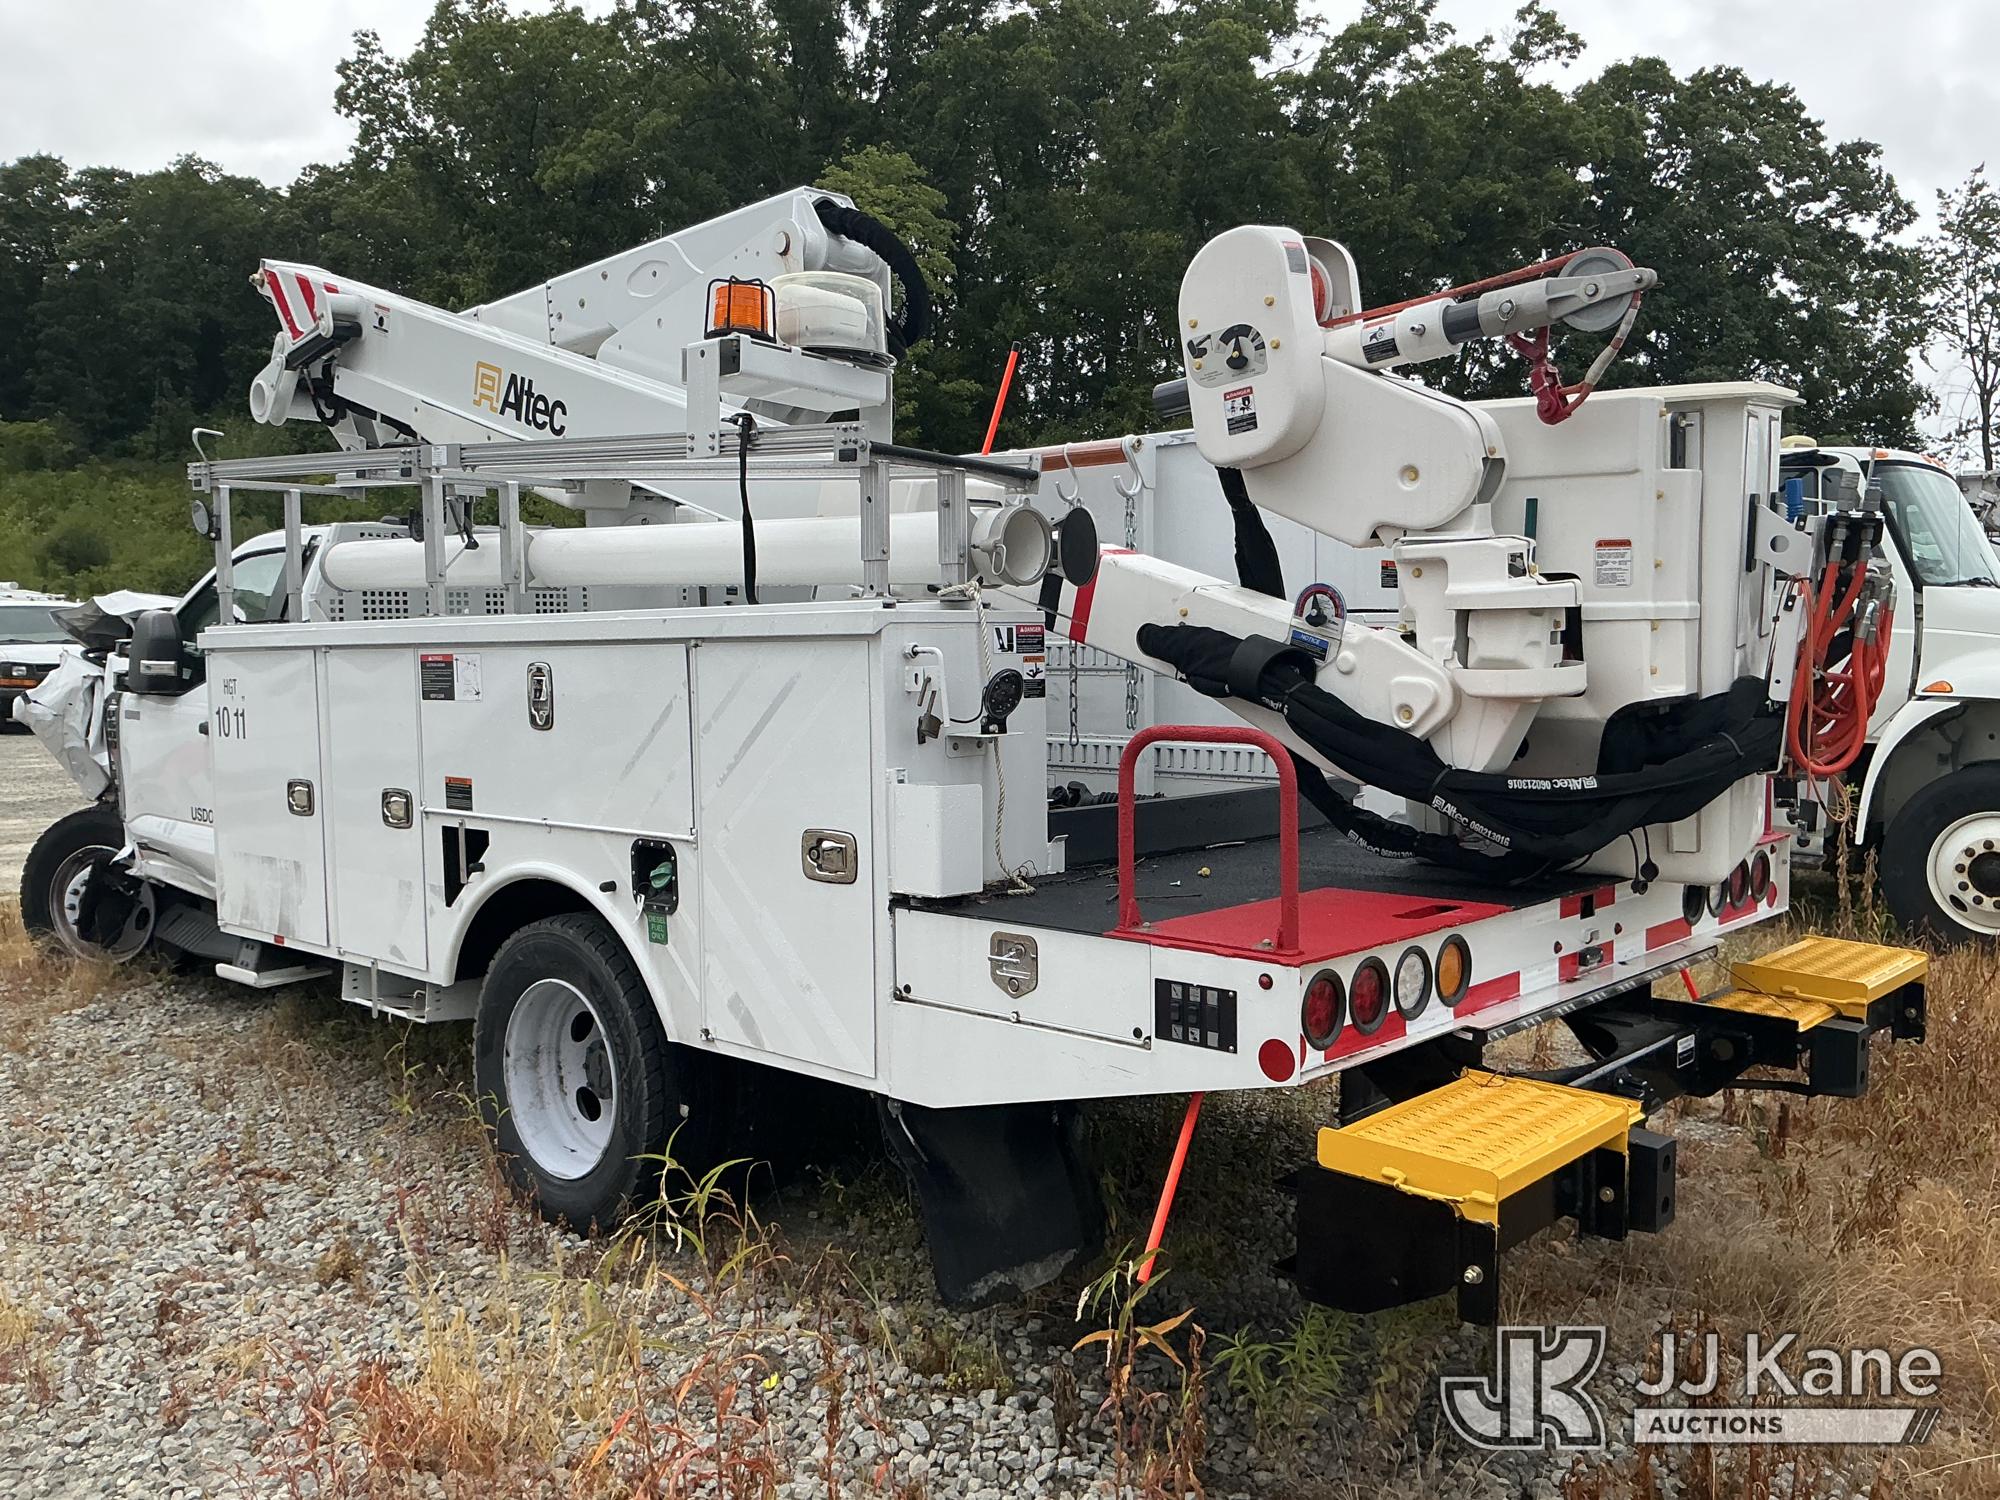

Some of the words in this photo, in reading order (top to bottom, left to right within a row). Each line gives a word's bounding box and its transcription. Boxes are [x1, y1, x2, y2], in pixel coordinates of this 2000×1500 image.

[499, 372, 567, 436] Altec
[1301, 633, 1320, 645] NOTICE
[1508, 779, 1551, 790] 060213016
[1552, 777, 1582, 790] Altec
[1443, 803, 1469, 827] Altec
[1469, 820, 1511, 847] 060213016
